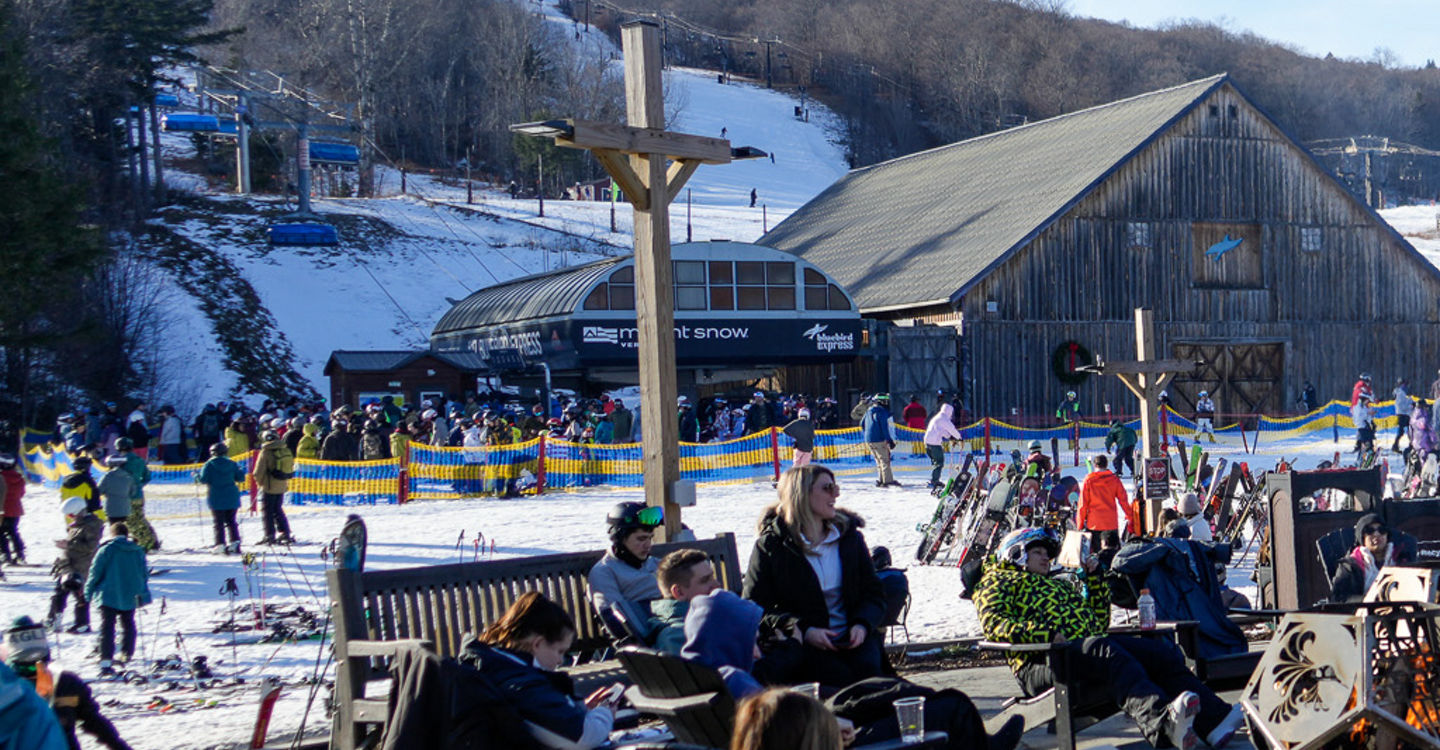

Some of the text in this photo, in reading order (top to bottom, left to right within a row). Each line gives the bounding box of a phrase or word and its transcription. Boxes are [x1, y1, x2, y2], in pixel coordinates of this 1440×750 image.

[620, 326, 748, 339] mnt snow
[817, 332, 853, 341] bluebird
[817, 341, 854, 352] express
[1148, 466, 1166, 475] STOP
